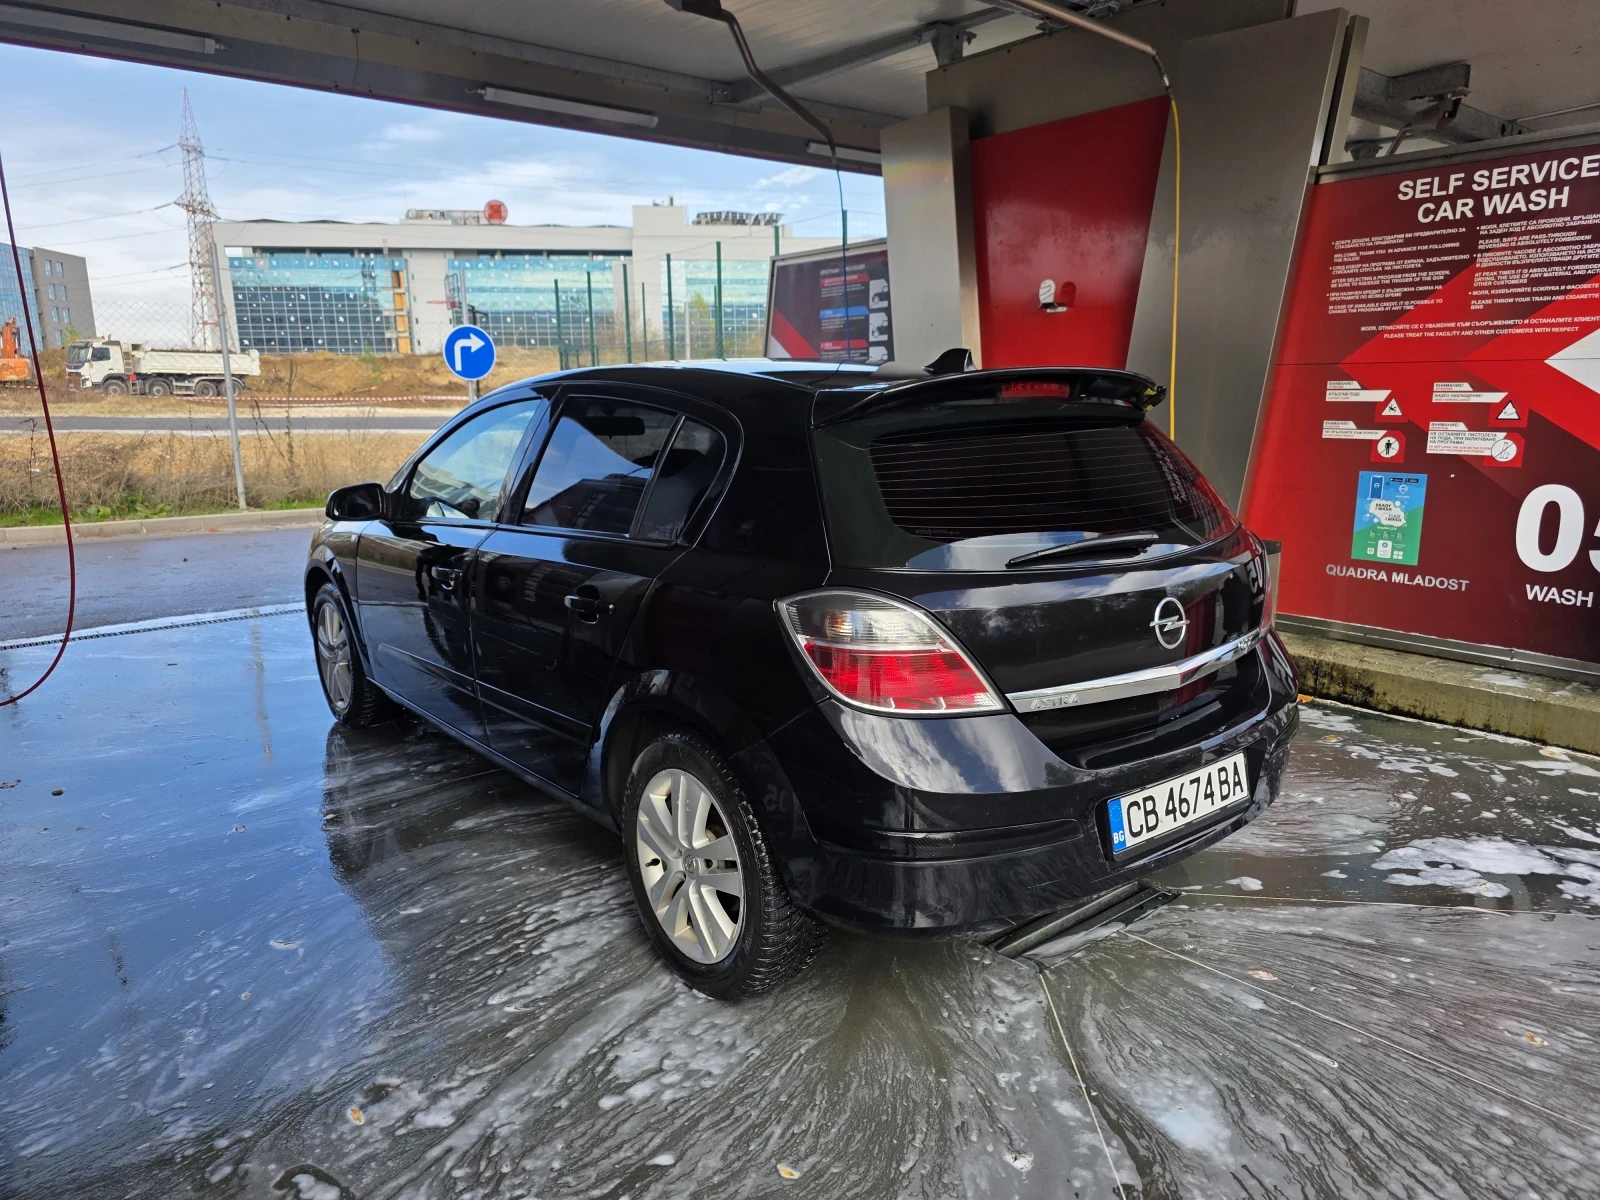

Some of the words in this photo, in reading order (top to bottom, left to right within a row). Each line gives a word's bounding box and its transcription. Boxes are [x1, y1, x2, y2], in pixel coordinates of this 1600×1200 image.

[1398, 173, 1465, 201] SELF
[1472, 154, 1600, 191] SERVICE
[1417, 198, 1474, 223] CAR
[1483, 186, 1570, 216] WASH
[1517, 238, 1554, 246] ABSOLUTELY
[1555, 235, 1592, 243] FORBIDDEN!
[1531, 231, 1577, 240] PASS-THROUGH
[1515, 484, 1600, 574] 0
[1326, 564, 1388, 582] QUADRA
[1391, 572, 1470, 591] MLADOST
[1526, 584, 1594, 608] WASH
[1030, 694, 1080, 709] ASTRA
[1126, 795, 1159, 838] CB
[1165, 772, 1215, 822] 4674
[1218, 761, 1244, 802] BA
[1113, 831, 1124, 844] BG
